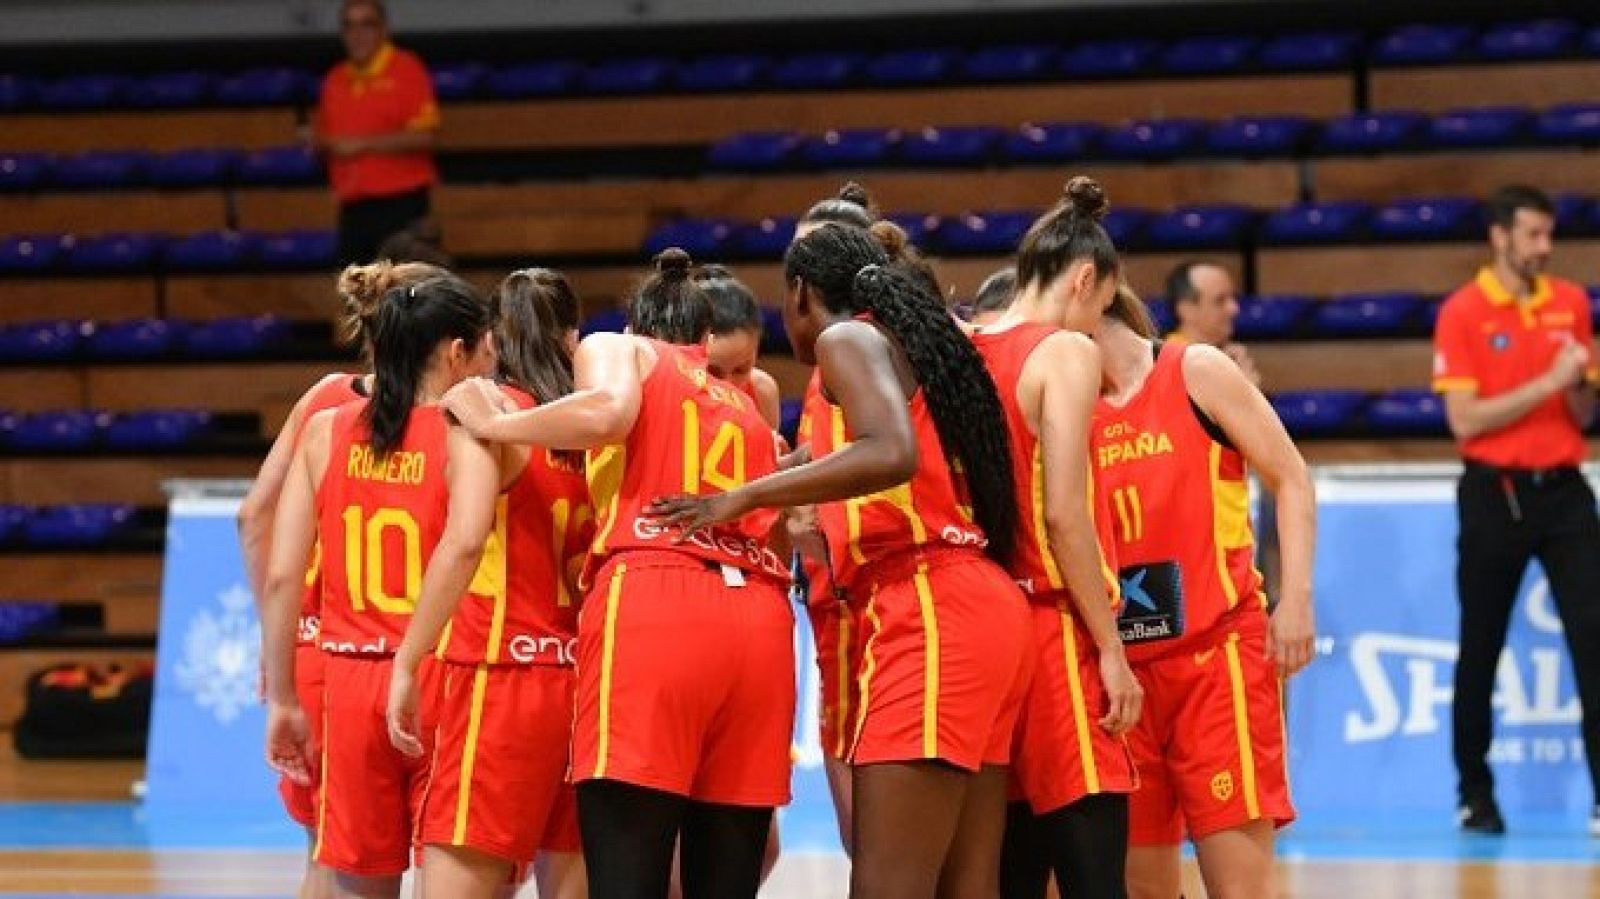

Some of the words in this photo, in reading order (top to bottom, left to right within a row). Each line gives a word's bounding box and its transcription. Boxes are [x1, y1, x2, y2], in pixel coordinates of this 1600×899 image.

[682, 399, 745, 494] 14
[1098, 431, 1175, 469] SPAÑA
[1114, 485, 1142, 542] 11
[343, 505, 421, 614] 10
